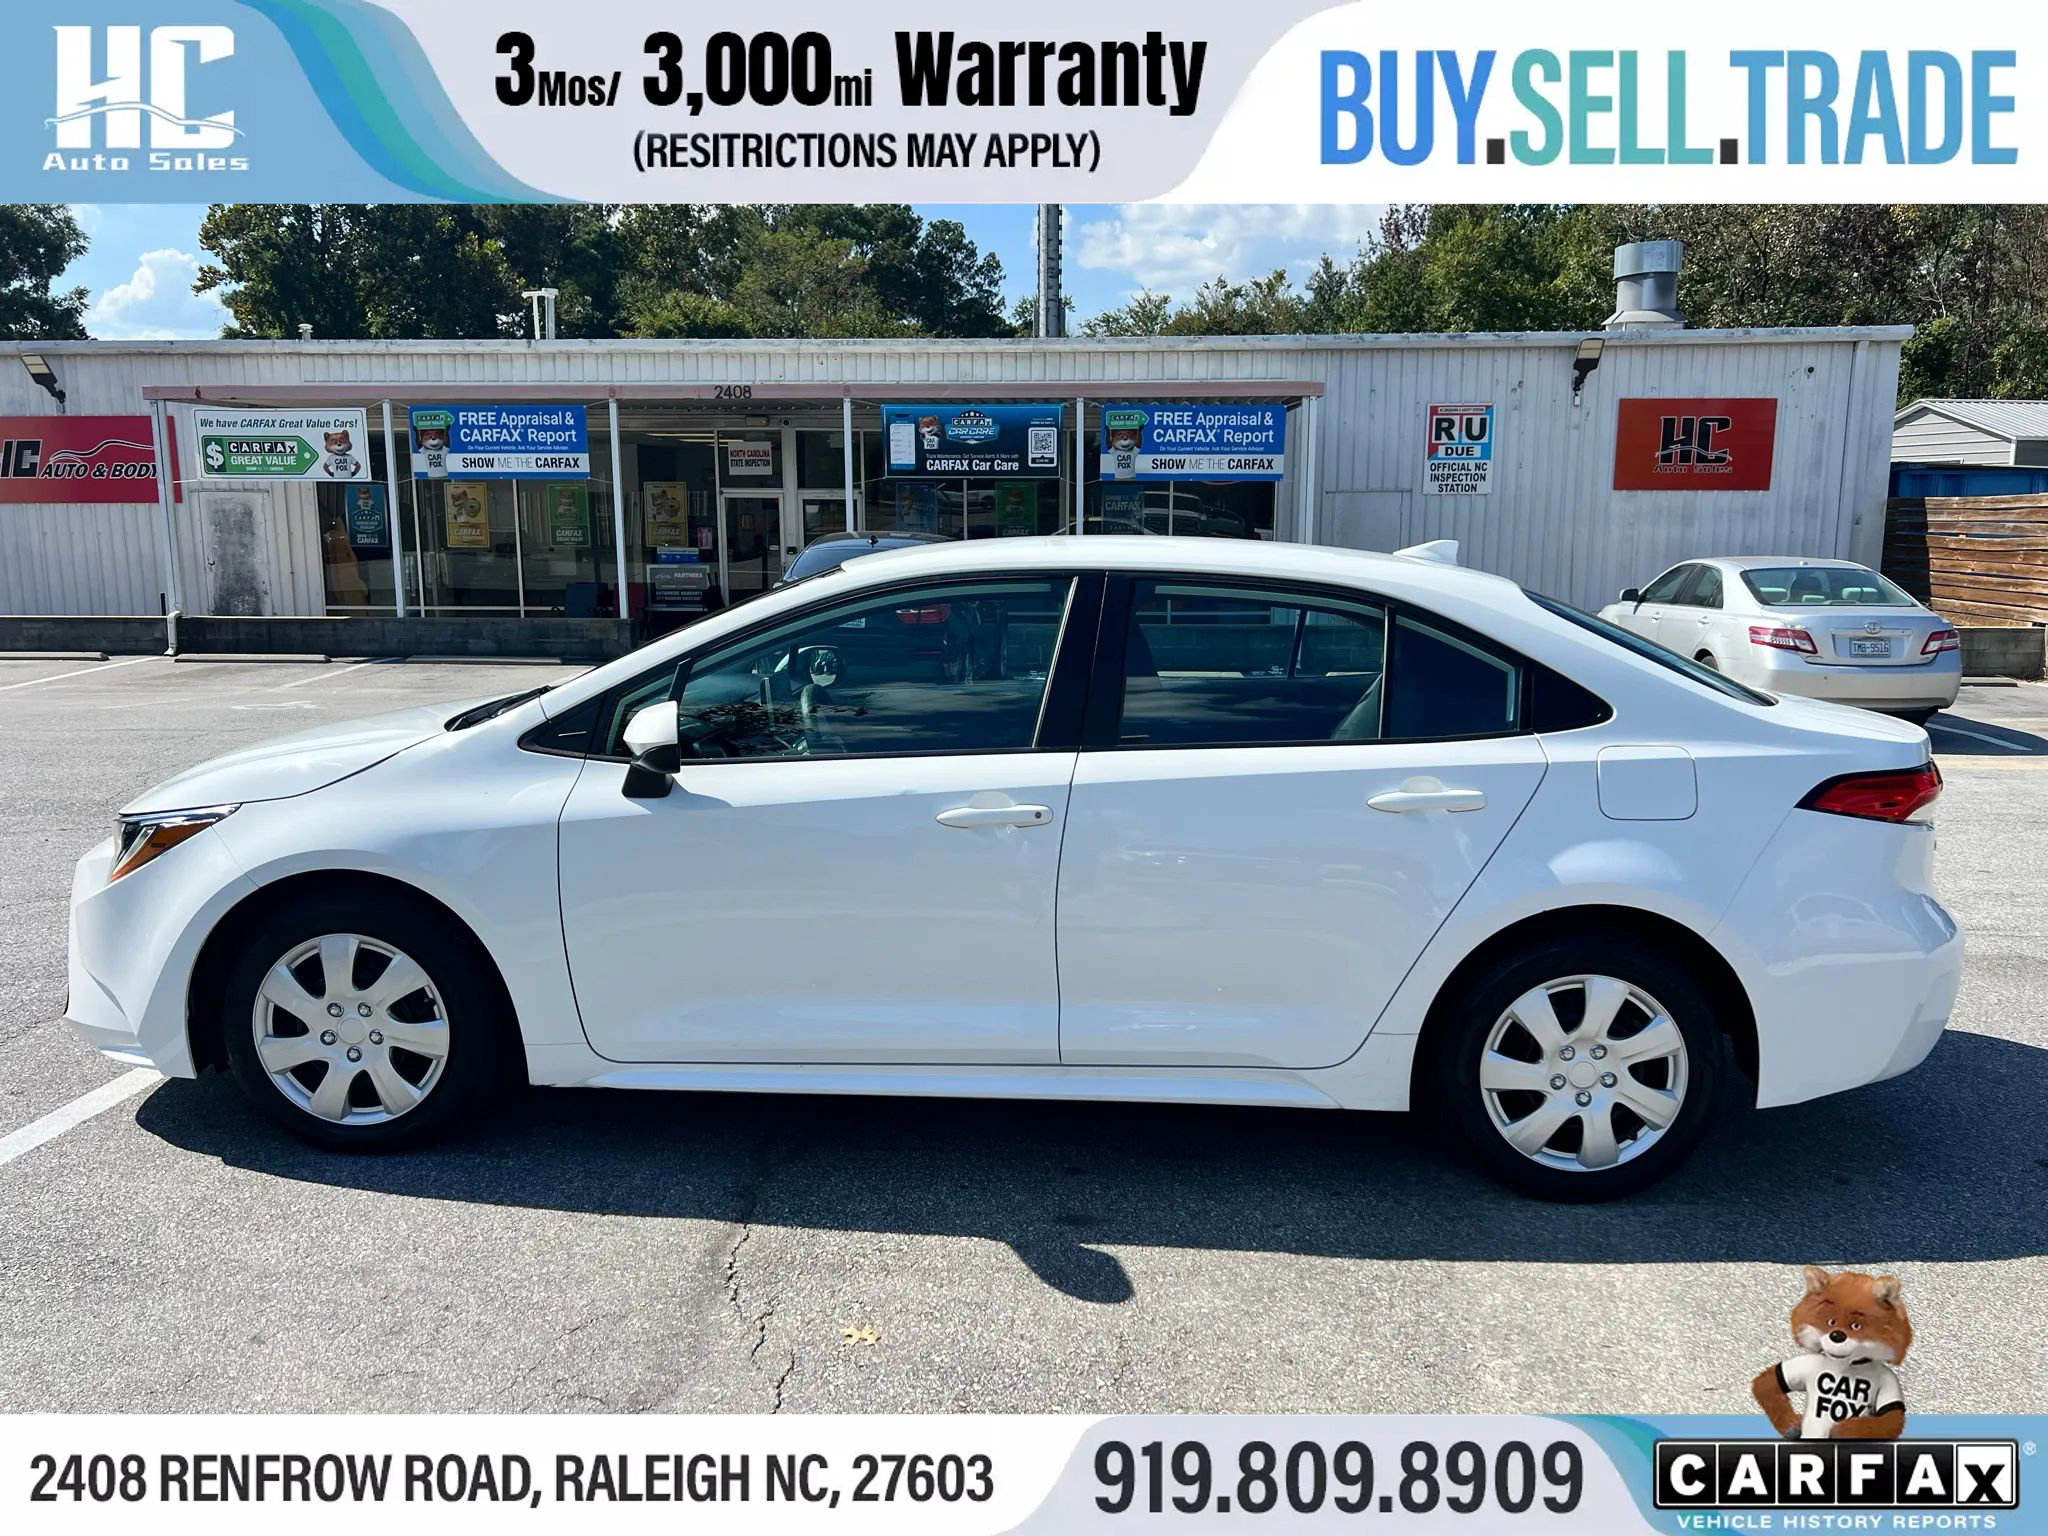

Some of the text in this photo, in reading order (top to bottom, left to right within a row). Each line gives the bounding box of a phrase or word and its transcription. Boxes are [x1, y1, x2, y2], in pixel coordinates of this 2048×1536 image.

[714, 385, 752, 399] 2408
[200, 418, 358, 428] We have CARFAX Great Value Cars!
[459, 411, 575, 428] FREE Appraisal &
[1154, 411, 1274, 429] FREE Appraisal &
[949, 427, 995, 435] CAR CARE
[460, 429, 577, 445] CARFAX Report
[1153, 429, 1274, 446] CARFAX Report
[1659, 416, 1732, 465] HC
[229, 442, 298, 453] CARFAX
[1445, 446, 1474, 456] DUE
[730, 449, 770, 457] NORTH CAROLINA
[231, 456, 297, 465] GREAT VALUE
[462, 457, 580, 468] SHOW ME THE CARFAX
[730, 459, 770, 467] STATE INSPECTION
[926, 459, 1019, 471] CARFAX Car Care
[1151, 458, 1273, 470] SHOW ME THE CARFAX
[39, 462, 89, 479] AUTO
[91, 462, 108, 479] &
[1430, 462, 1488, 472] OFFICIAL NC
[1430, 473, 1487, 482] INSPECTION
[1437, 483, 1478, 493] STATION
[1105, 501, 1140, 511] CARFAX
[455, 528, 480, 536] CARFAX
[556, 529, 583, 537] CARFAX
